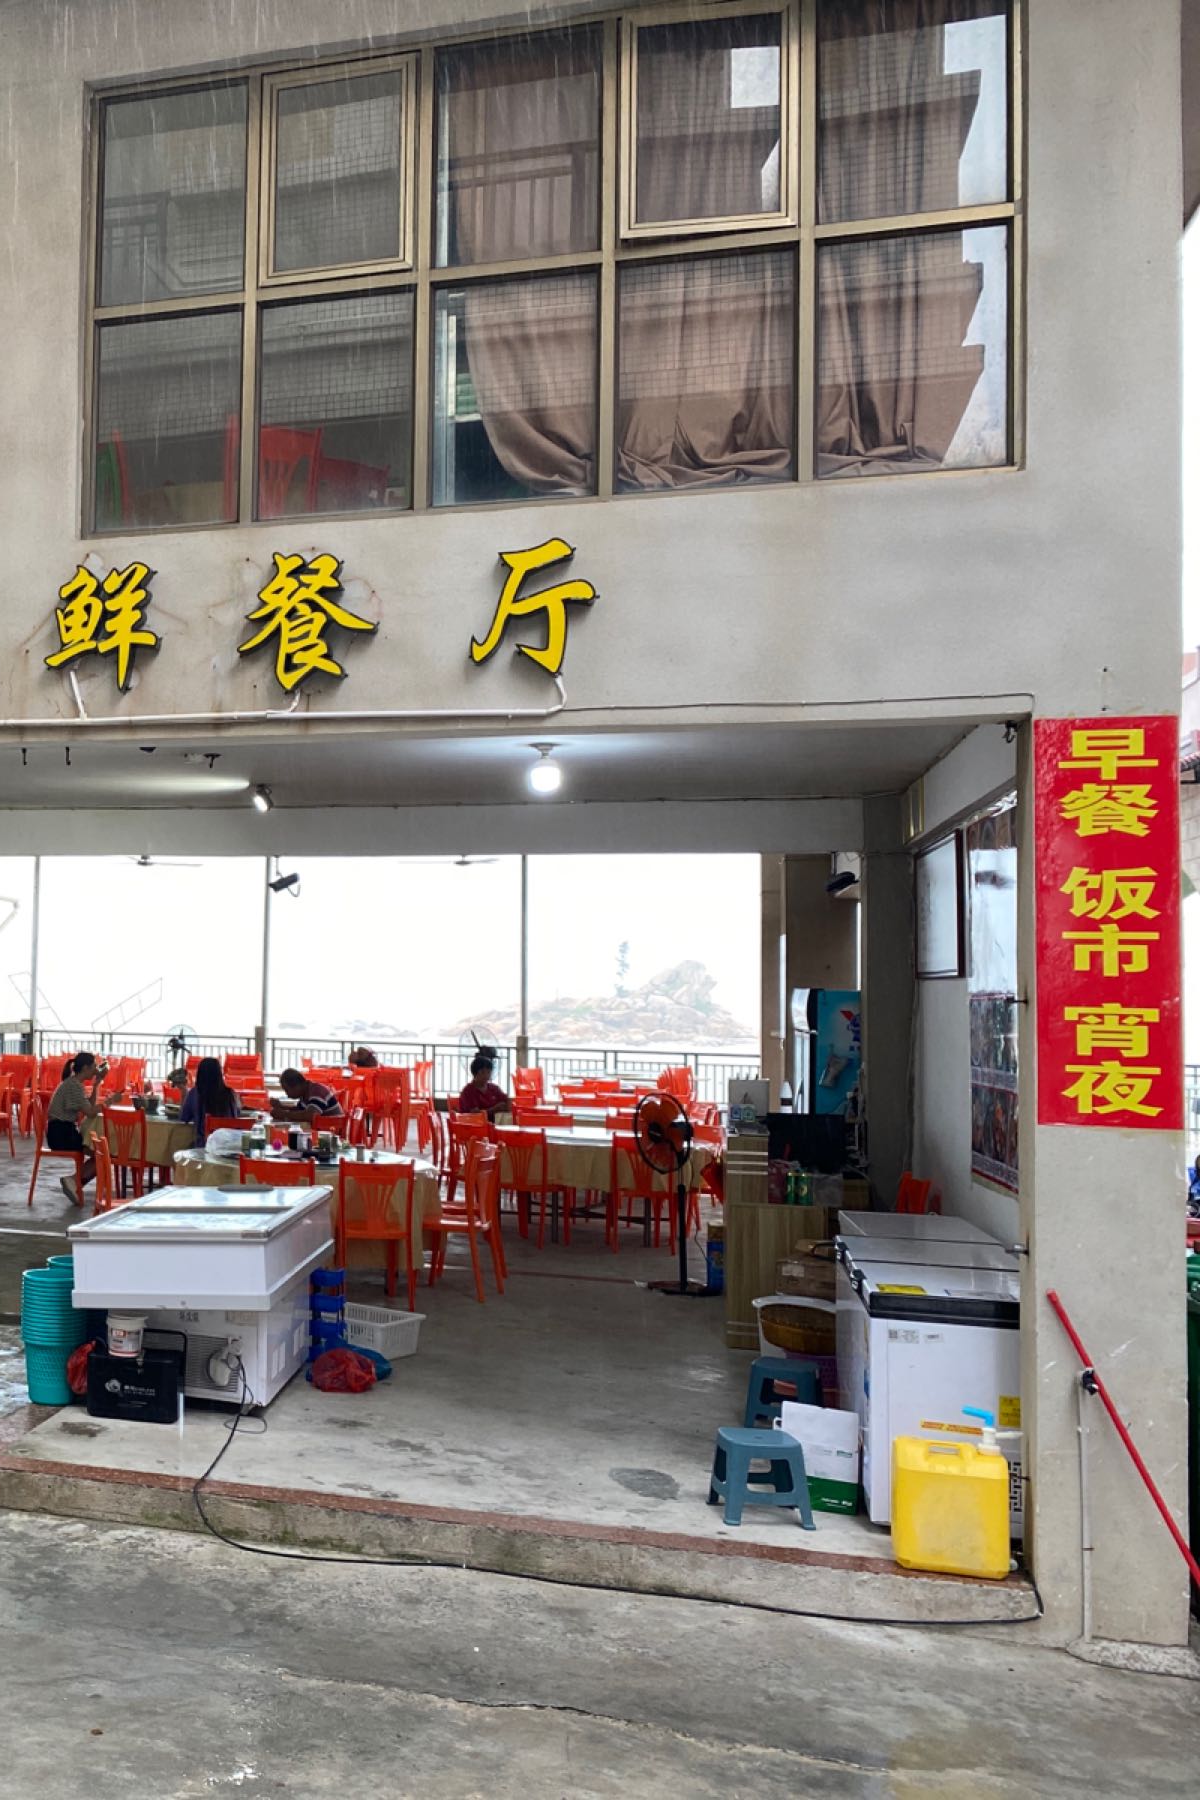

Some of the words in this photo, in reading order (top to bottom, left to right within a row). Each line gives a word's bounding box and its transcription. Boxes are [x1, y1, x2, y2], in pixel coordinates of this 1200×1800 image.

[1059, 728, 1159, 837] 早餐
[1061, 866, 1161, 977] 饭市
[1062, 1003, 1164, 1117] 宵夜
